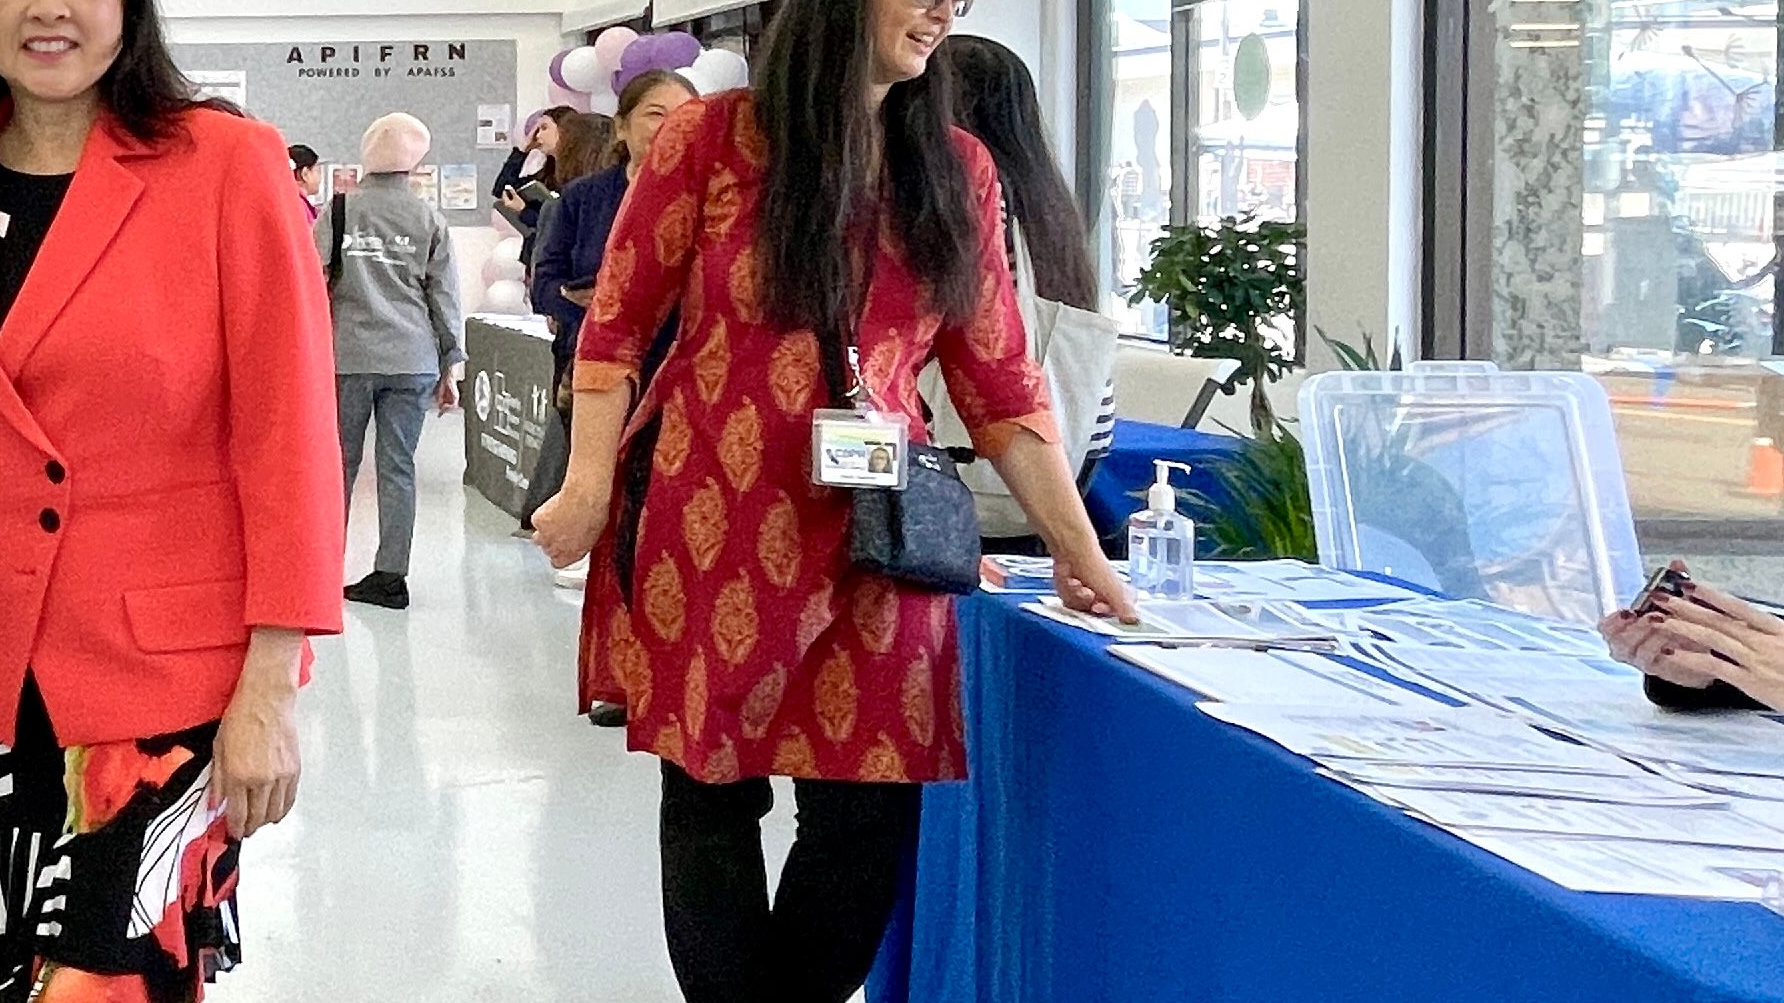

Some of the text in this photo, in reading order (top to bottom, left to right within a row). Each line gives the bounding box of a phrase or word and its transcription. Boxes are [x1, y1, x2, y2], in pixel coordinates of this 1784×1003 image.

[286, 43, 466, 64] APIFRN
[298, 67, 360, 78] POWERED
[374, 67, 391, 78] BY
